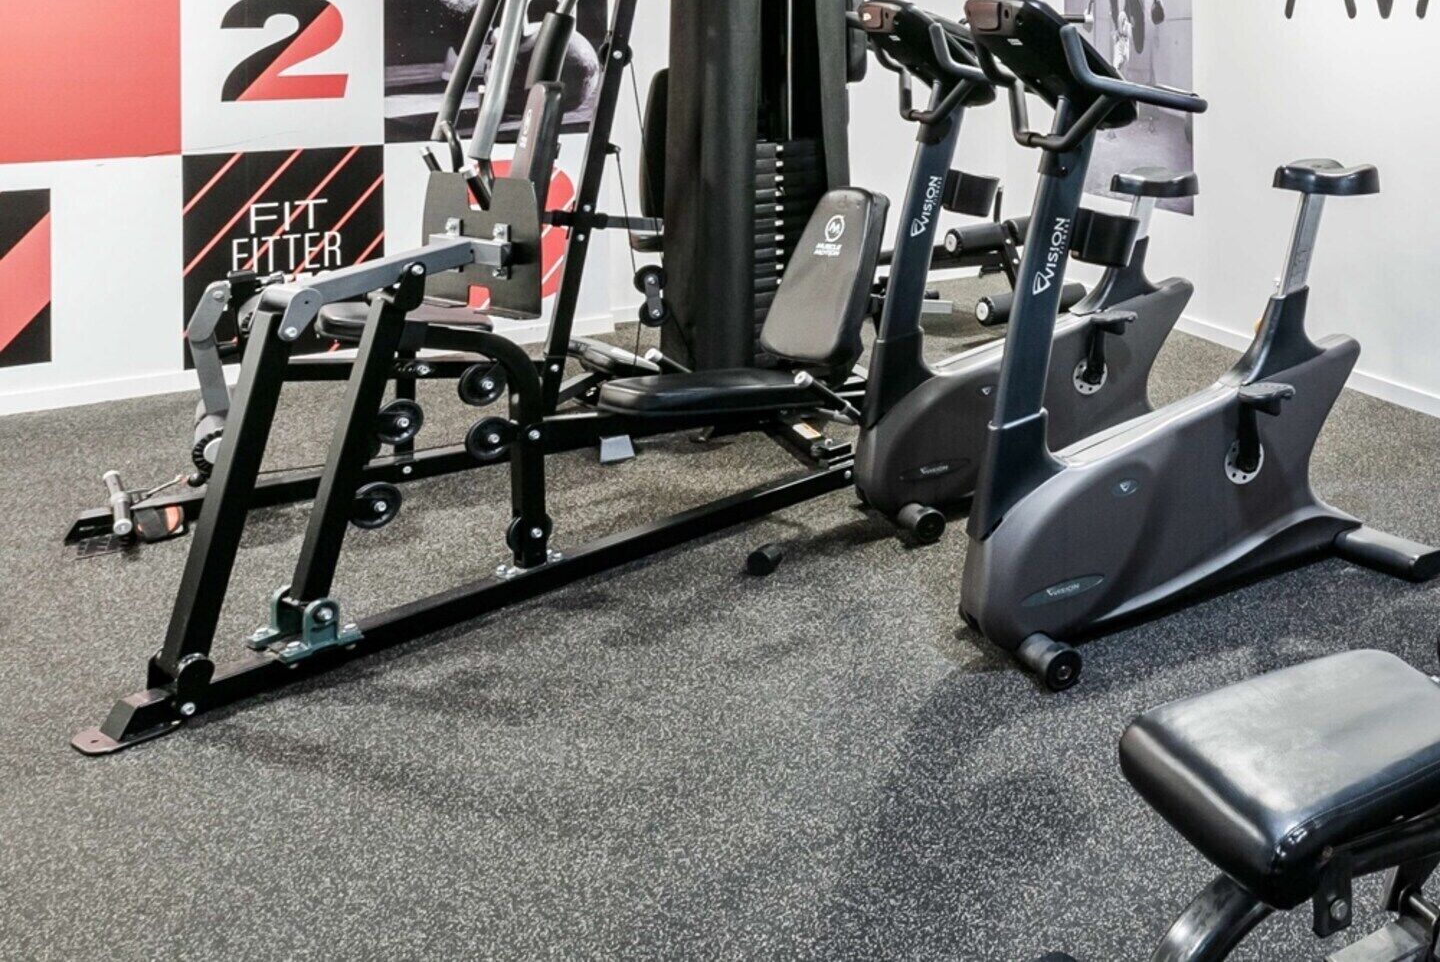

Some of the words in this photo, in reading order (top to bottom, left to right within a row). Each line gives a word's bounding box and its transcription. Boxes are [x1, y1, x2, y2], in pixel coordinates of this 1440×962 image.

[250, 198, 328, 235] FIT
[232, 231, 342, 274] FITTER
[1043, 218, 1067, 279] VISION
